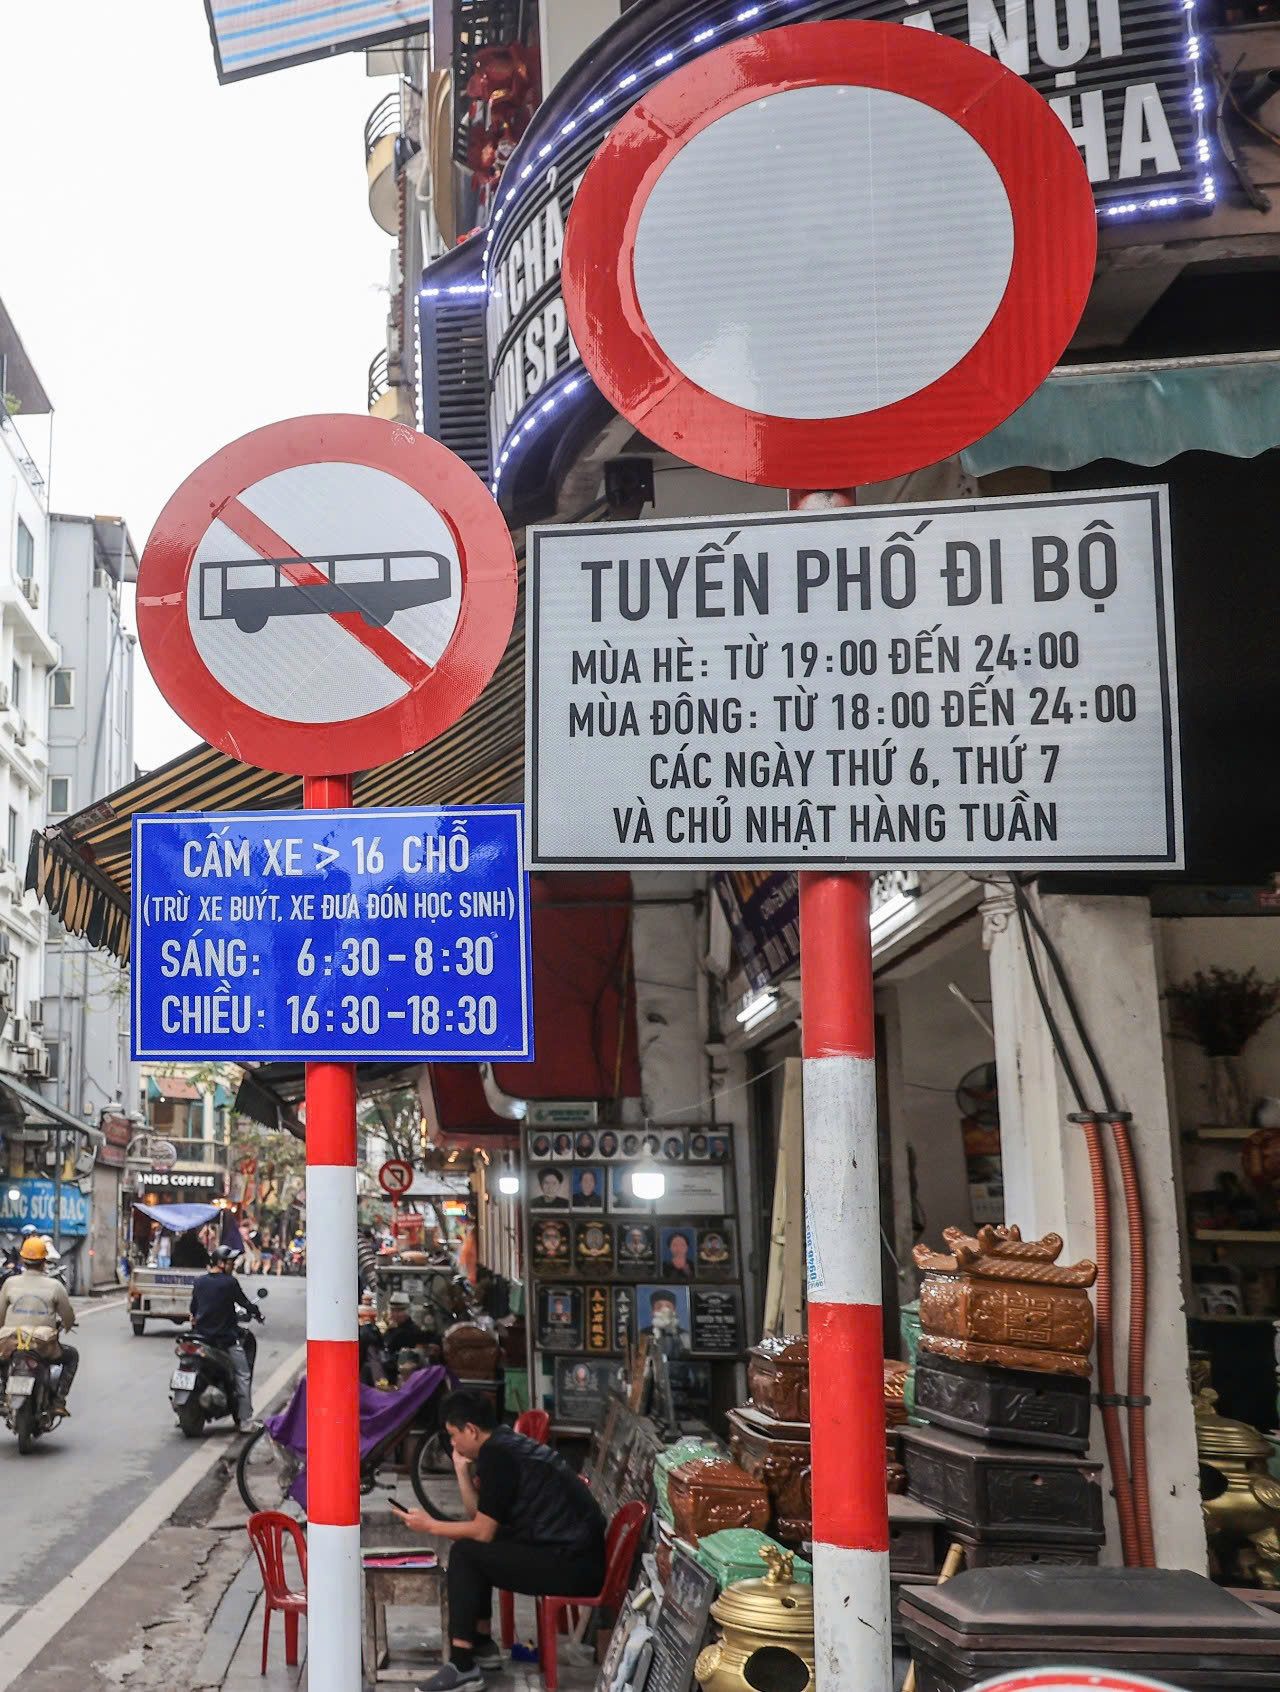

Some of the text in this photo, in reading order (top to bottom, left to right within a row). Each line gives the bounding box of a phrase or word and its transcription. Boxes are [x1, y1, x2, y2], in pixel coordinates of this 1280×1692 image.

[525, 296, 581, 395] SP
[581, 519, 1118, 622] TUYẾN PHỐ ĐI BỘ
[572, 624, 1079, 685] MÙA HÈ: TỪ 19:00 ĐẾN 24:00
[569, 675, 1137, 738] MÙA ĐÔNG: TỪ 18:00 ĐẾN 24:00
[650, 735, 1060, 790] CÁC NGÀY THỨ 6, THỨ 7
[183, 826, 250, 878] CẤM
[262, 839, 303, 876] XE
[352, 836, 384, 874] 16
[402, 819, 469, 874] CHỖ
[614, 792, 1058, 851] VÀ CHỦ NHẬT HÀNG TUẦN
[144, 886, 515, 926] (TRỪ XE BUÝT, XE ĐƯA ĐÓN HỌC SINH)
[161, 929, 260, 977] SÁNG:
[162, 980, 265, 1034] CHIỀU:
[170, 1175, 215, 1187] COFFEE
